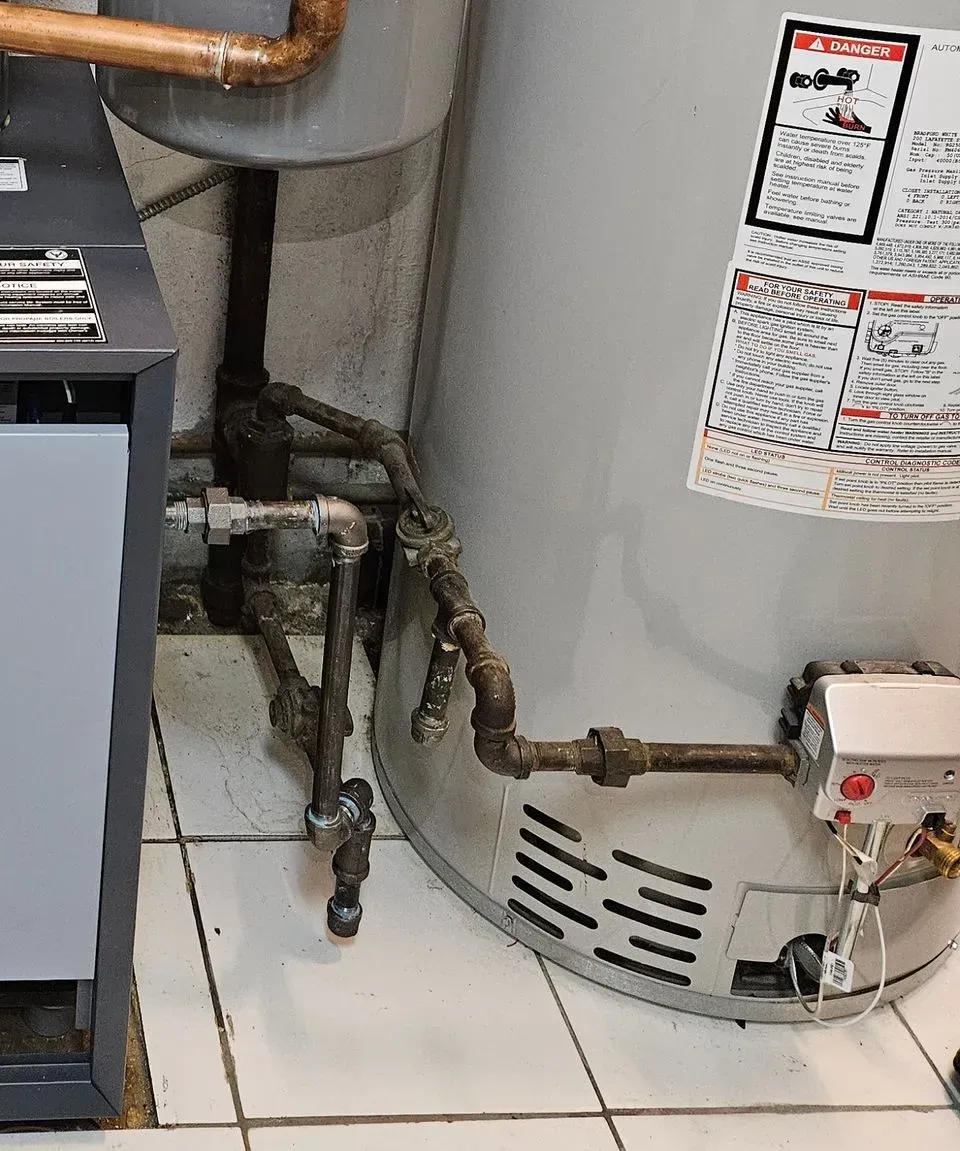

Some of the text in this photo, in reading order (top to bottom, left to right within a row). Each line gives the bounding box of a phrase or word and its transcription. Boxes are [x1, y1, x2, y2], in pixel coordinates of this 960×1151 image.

[831, 41, 890, 57] DANGER
[837, 96, 859, 104] HOT
[842, 122, 865, 130] BURN
[800, 133, 836, 144] temperature
[749, 285, 846, 306] READ BEFORE OPERATING
[782, 285, 803, 294] YOUR
[804, 289, 833, 298] SAFETY
[764, 451, 786, 459] STATUS
